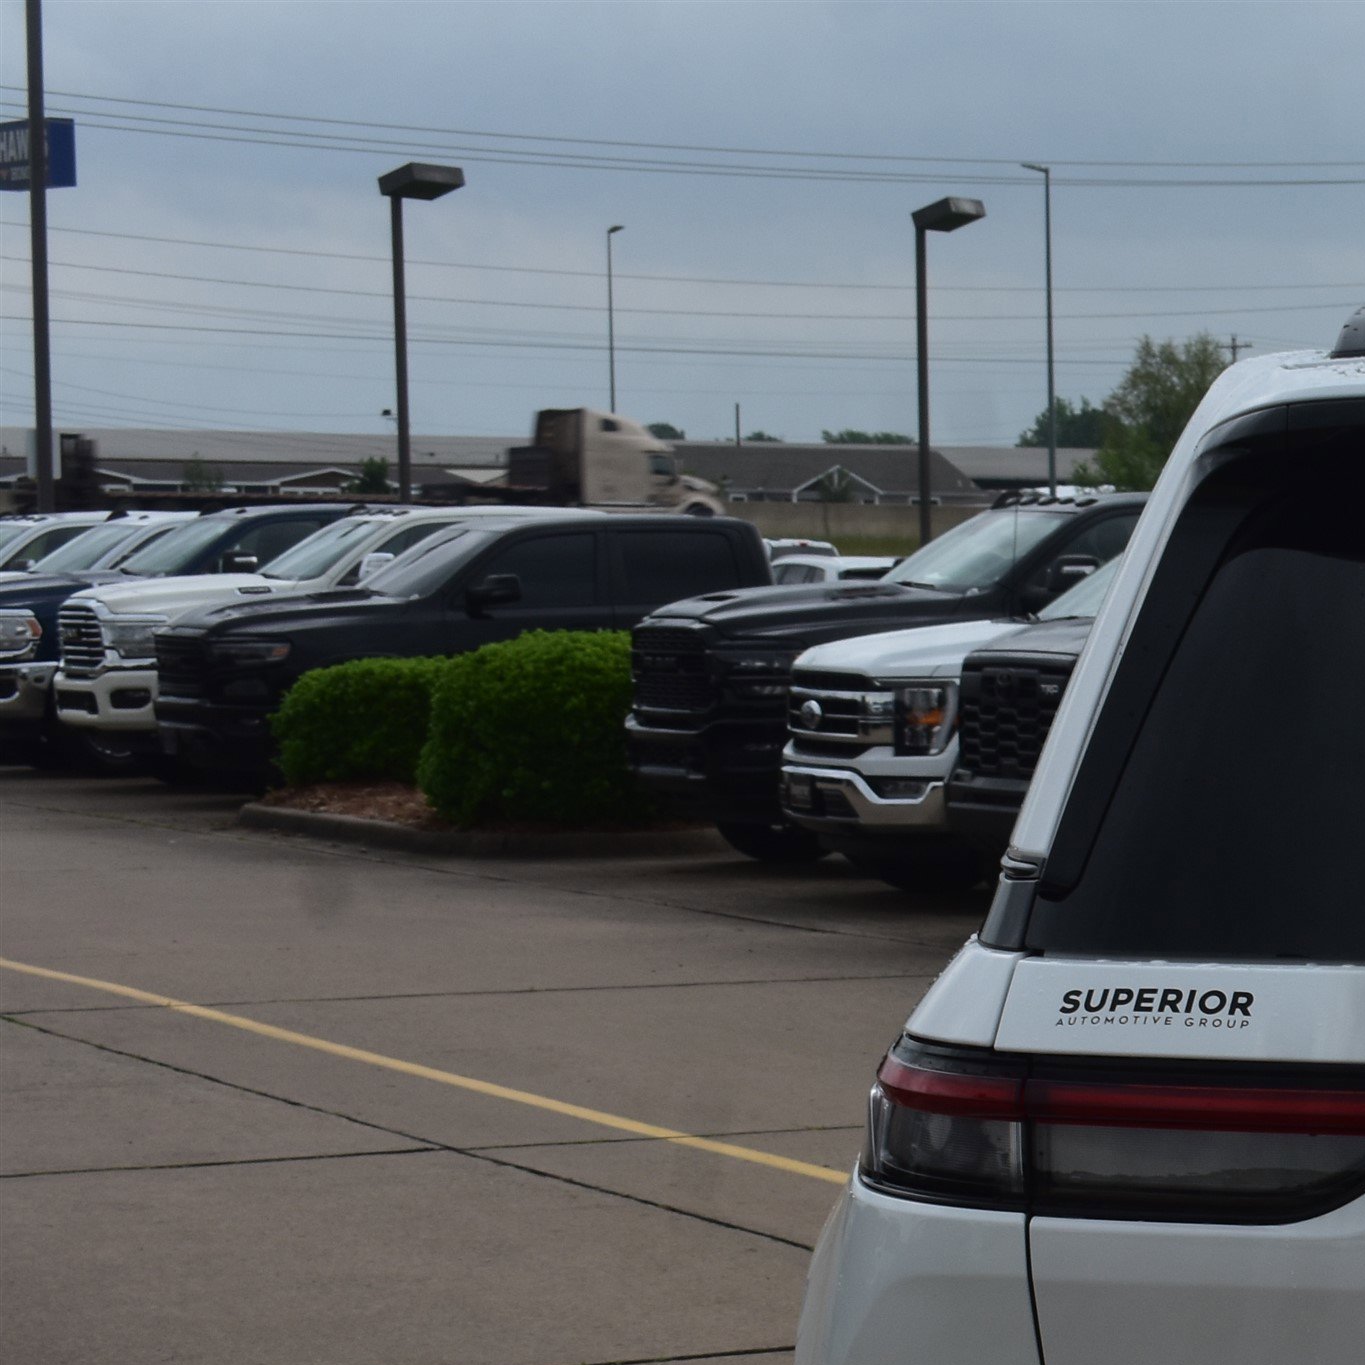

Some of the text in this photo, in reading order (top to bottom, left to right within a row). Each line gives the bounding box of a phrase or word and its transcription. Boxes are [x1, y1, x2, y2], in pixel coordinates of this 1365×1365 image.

[1059, 988, 1255, 1017] SUPERIOR
[1056, 1016, 1251, 1029] AUTOMOTIVE GROUP
